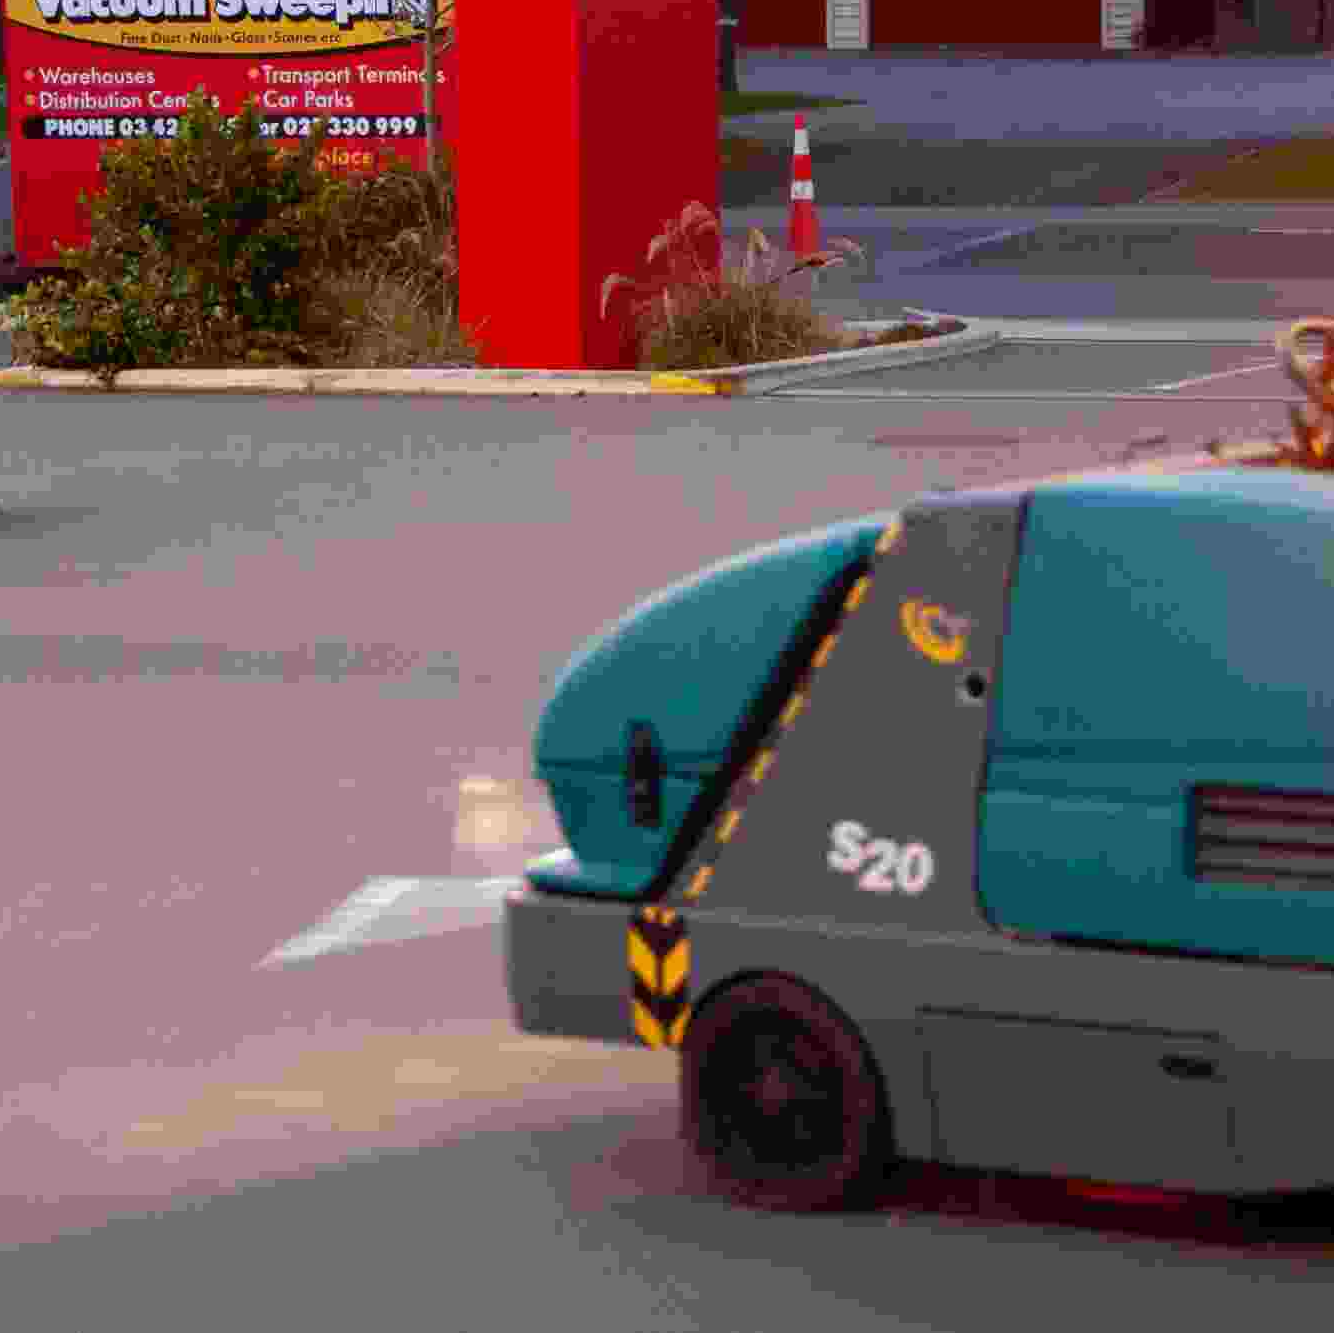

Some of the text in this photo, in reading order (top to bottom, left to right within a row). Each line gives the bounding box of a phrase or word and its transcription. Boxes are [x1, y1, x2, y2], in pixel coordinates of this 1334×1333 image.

[151, 30, 180, 44] Dust
[38, 66, 156, 85] Warehouses
[260, 63, 445, 88] Transport Terminas
[39, 89, 220, 110] Distribution Cens
[262, 90, 354, 108] Car Parks
[43, 118, 115, 137] PHONE
[119, 118, 148, 137] 03
[328, 117, 370, 136] 330
[375, 117, 417, 136] 999
[827, 820, 934, 892] S20
